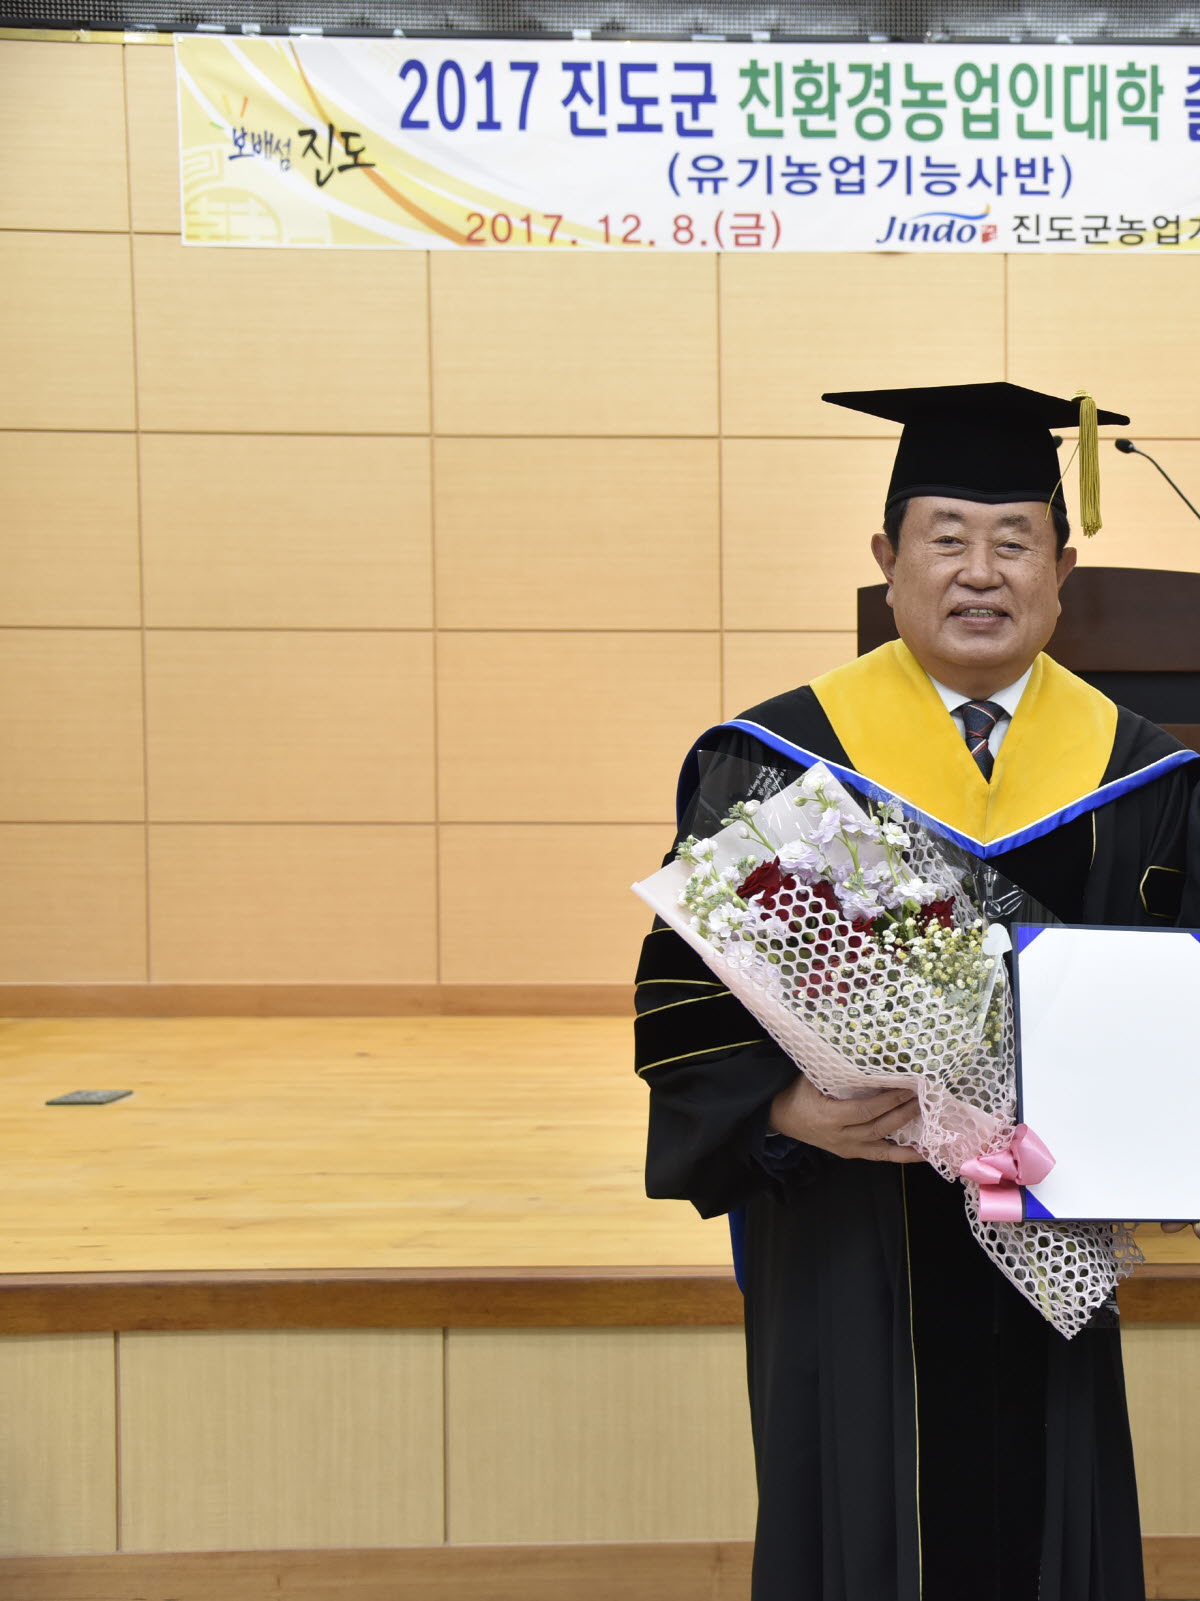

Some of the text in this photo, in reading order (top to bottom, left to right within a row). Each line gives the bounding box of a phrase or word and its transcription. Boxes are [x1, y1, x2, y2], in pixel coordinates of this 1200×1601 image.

[399, 59, 539, 131] 2017
[562, 61, 717, 138] 진도군
[739, 59, 1164, 142] 친환경농업인대학
[298, 122, 375, 187] 진도
[668, 152, 1071, 198] (유기농업기능사반)
[463, 211, 781, 248] 2017. 12. 8.(금)
[876, 215, 978, 244] Jindo
